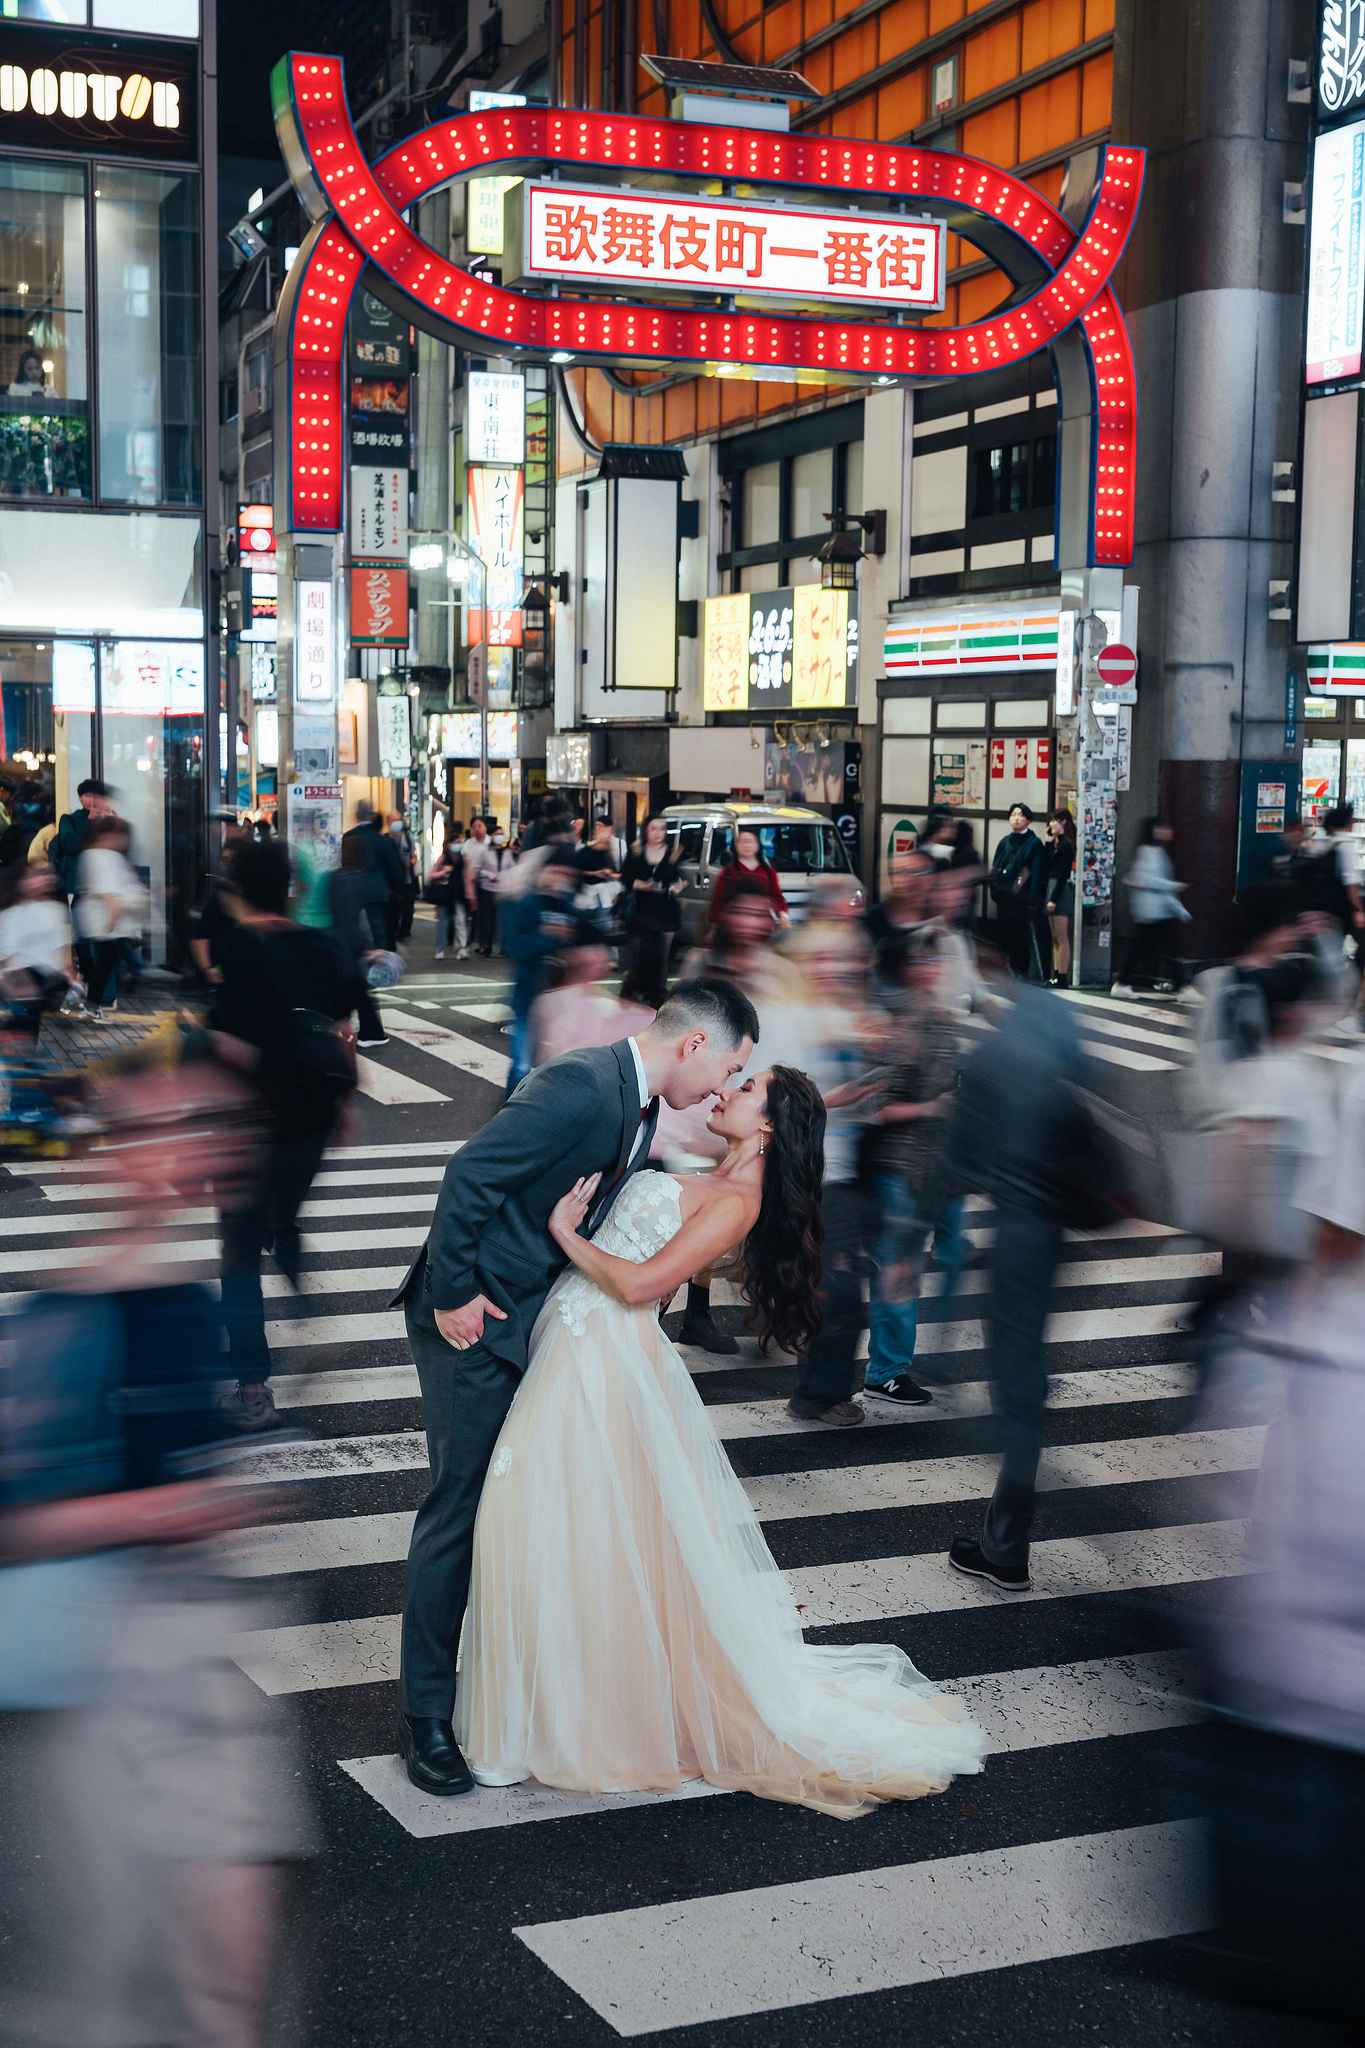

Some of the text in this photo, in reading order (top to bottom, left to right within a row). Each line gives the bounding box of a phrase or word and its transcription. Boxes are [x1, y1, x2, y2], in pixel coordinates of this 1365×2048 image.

[0, 64, 180, 129] DOUTOR
[544, 203, 926, 291] 歌舞伎町一番街
[484, 393, 499, 458] 東南荘
[374, 473, 385, 549] 芝浦ホルモン
[307, 591, 325, 689] 劇場通り
[489, 628, 513, 644] 2F
[992, 744, 1049, 770] たばこ
[1286, 729, 1295, 738] 17
[883, 1379, 900, 1392] N
